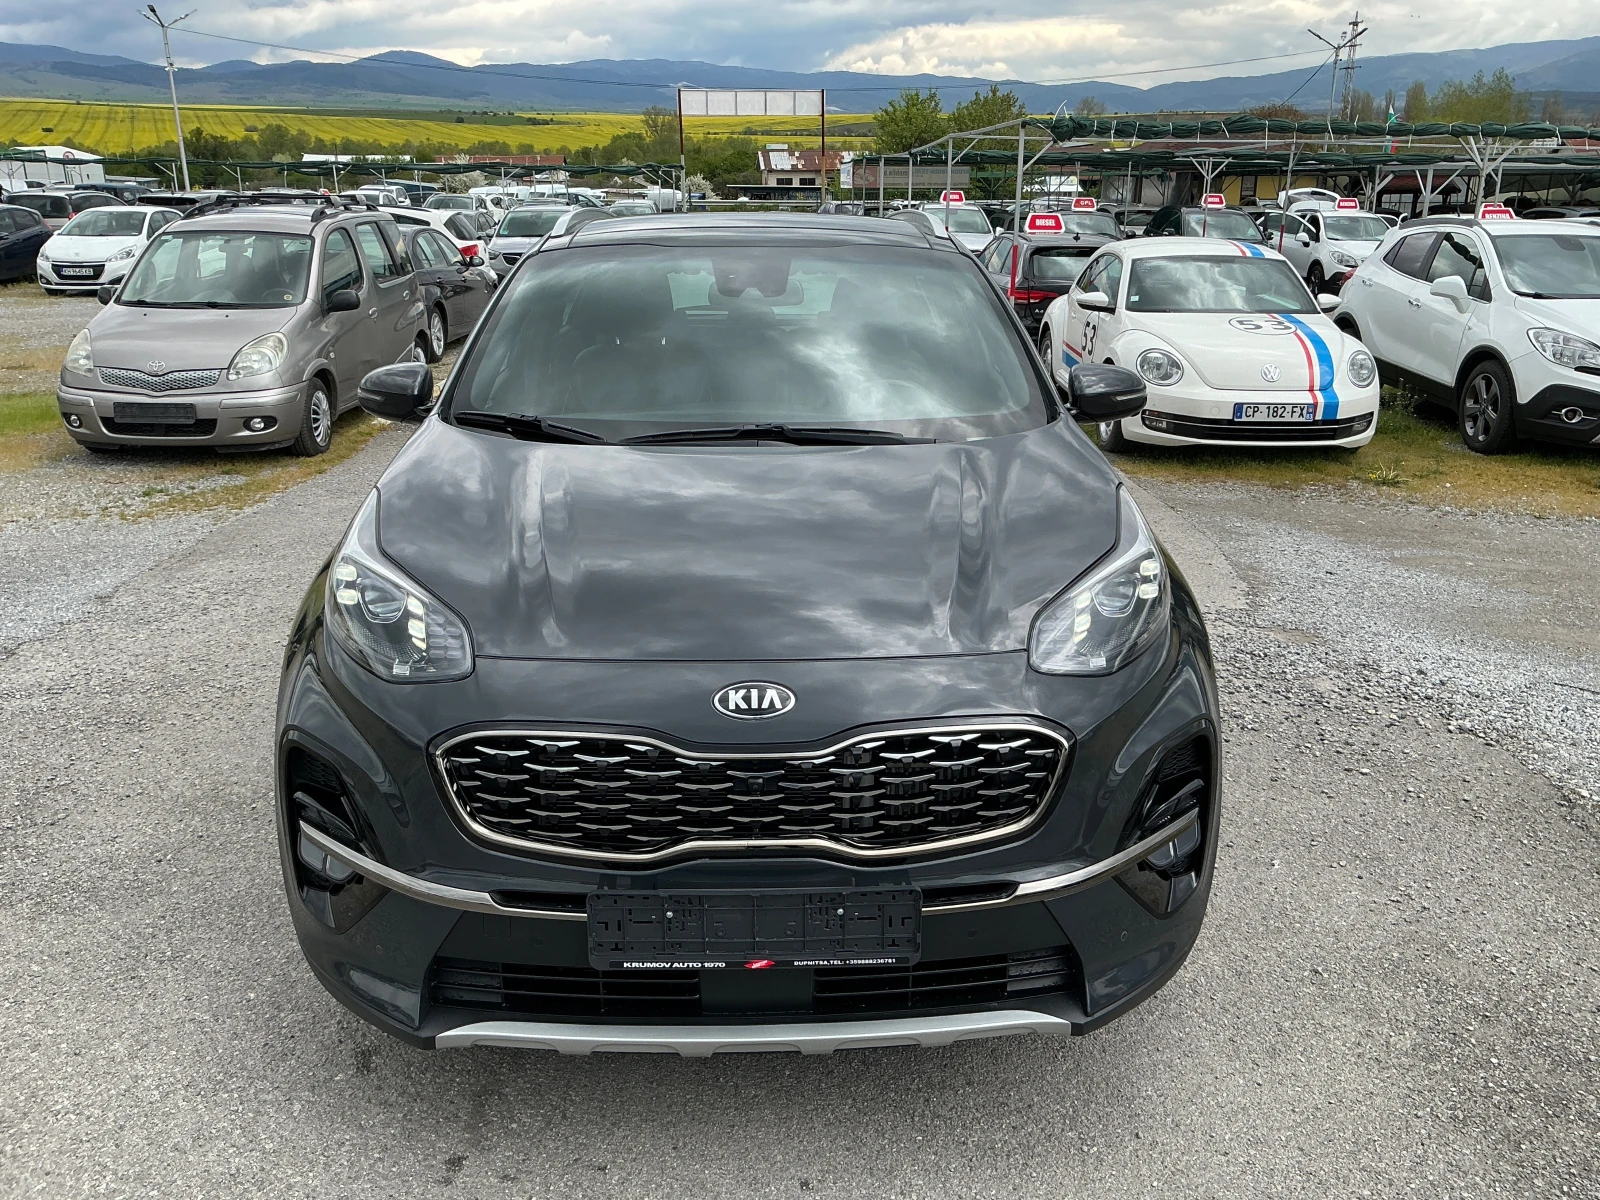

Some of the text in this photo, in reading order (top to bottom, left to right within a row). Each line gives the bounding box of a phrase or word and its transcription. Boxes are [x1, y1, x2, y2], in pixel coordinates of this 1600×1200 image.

[1035, 218, 1056, 227] DIESEL
[1235, 319, 1292, 331] 53
[1081, 320, 1097, 356] 53
[728, 688, 783, 710] KIA
